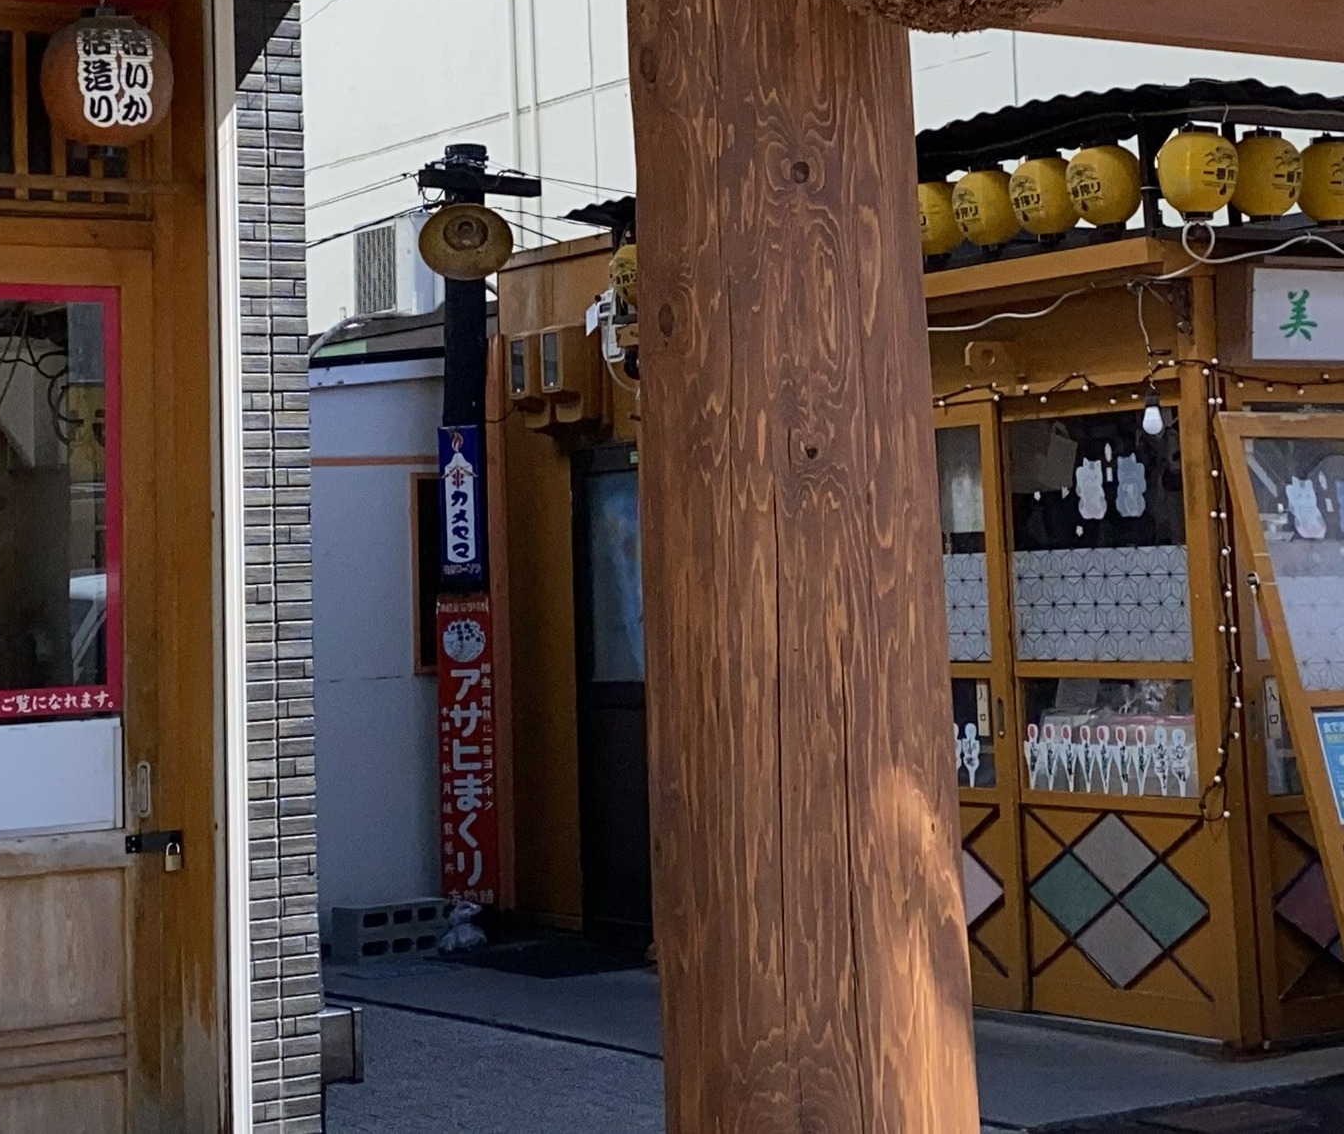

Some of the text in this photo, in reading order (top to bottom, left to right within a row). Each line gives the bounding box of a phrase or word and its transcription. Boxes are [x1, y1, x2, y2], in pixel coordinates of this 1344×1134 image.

[450, 490, 470, 559] カメヤマ
[448, 668, 483, 886] アサヒまくり
